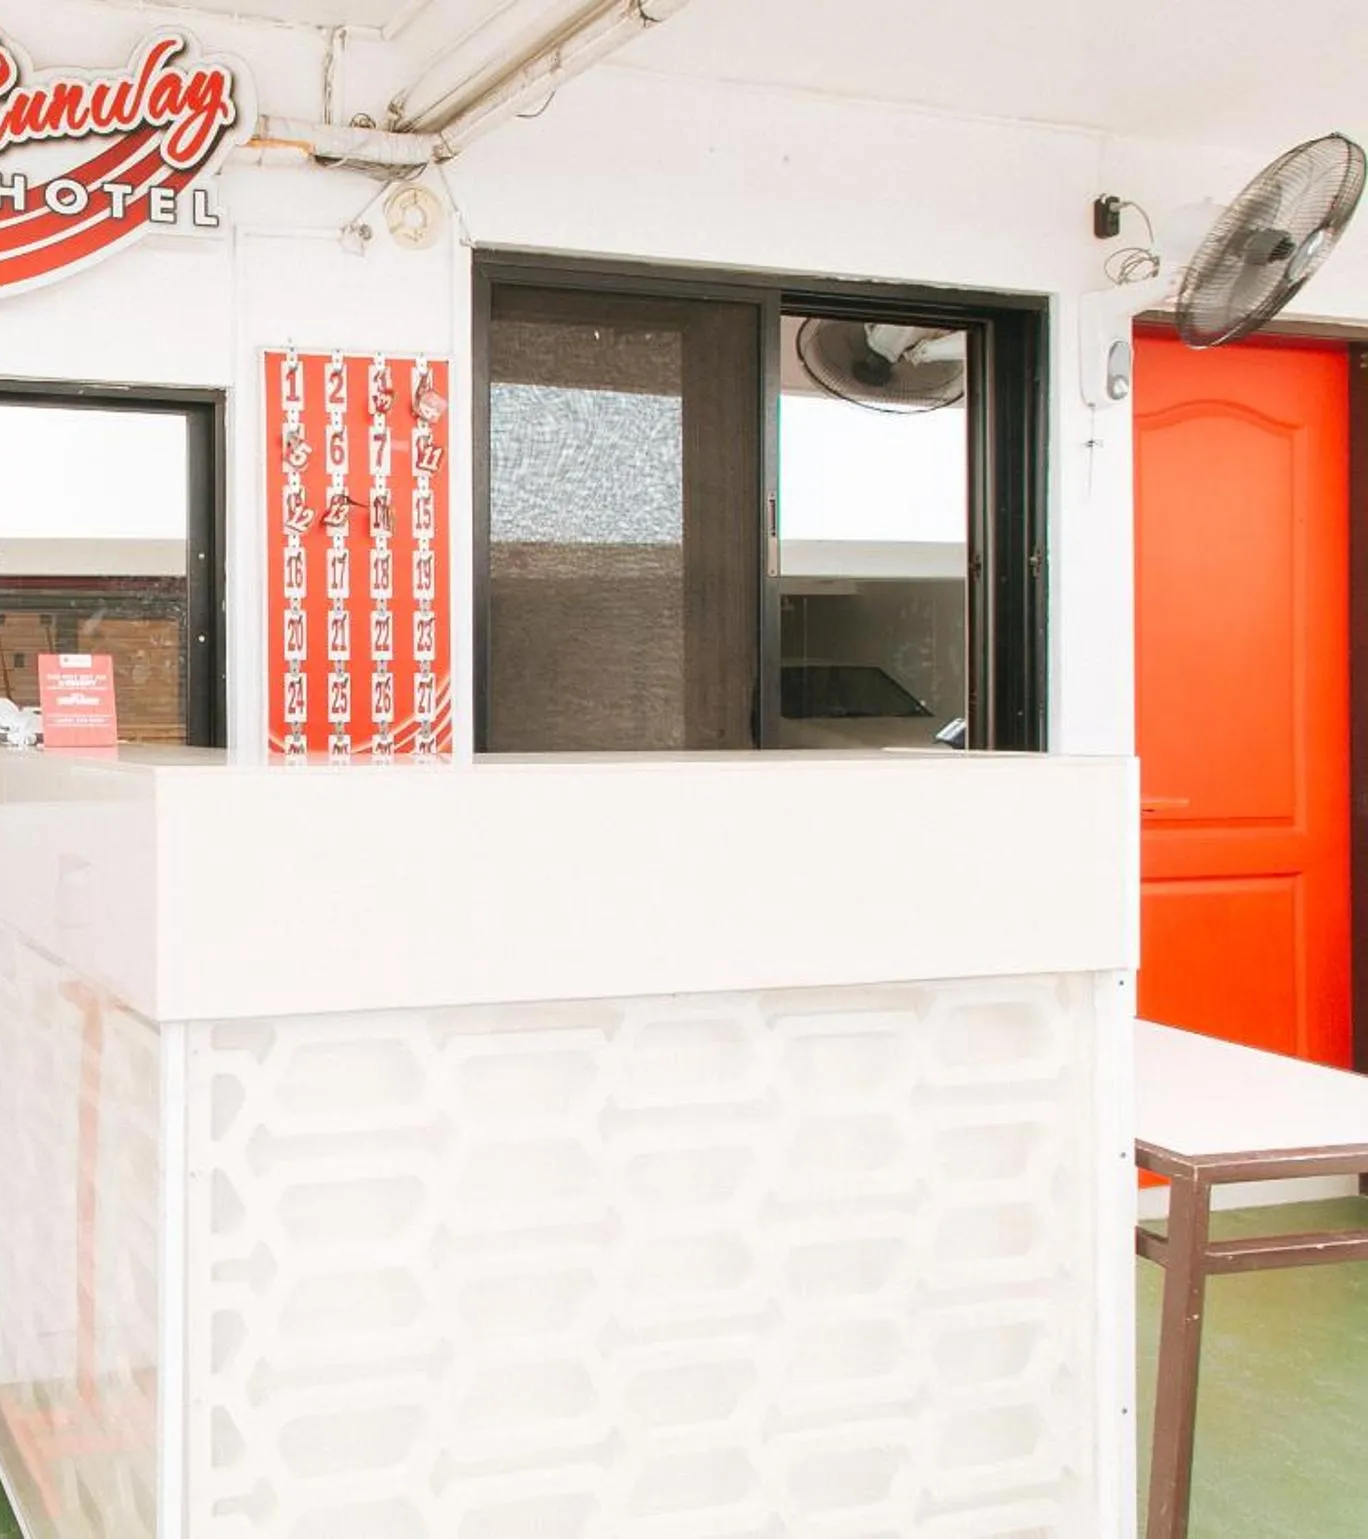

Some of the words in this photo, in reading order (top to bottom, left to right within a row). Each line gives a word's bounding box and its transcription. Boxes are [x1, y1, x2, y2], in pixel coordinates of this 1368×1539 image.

[286, 369, 300, 401] 1
[329, 371, 345, 403] 2
[330, 432, 345, 465] 6
[373, 434, 387, 467] 7
[416, 496, 432, 530] 15
[287, 554, 304, 589] 16
[331, 555, 346, 589] 17
[374, 556, 390, 589] 18
[416, 557, 432, 590] 19
[287, 618, 304, 651] 20
[331, 618, 347, 651] 21
[375, 618, 390, 651] 22
[417, 619, 433, 651] 23
[287, 680, 304, 713] 24
[331, 681, 348, 713] 25
[375, 681, 391, 713] 26
[417, 681, 432, 713] 27
